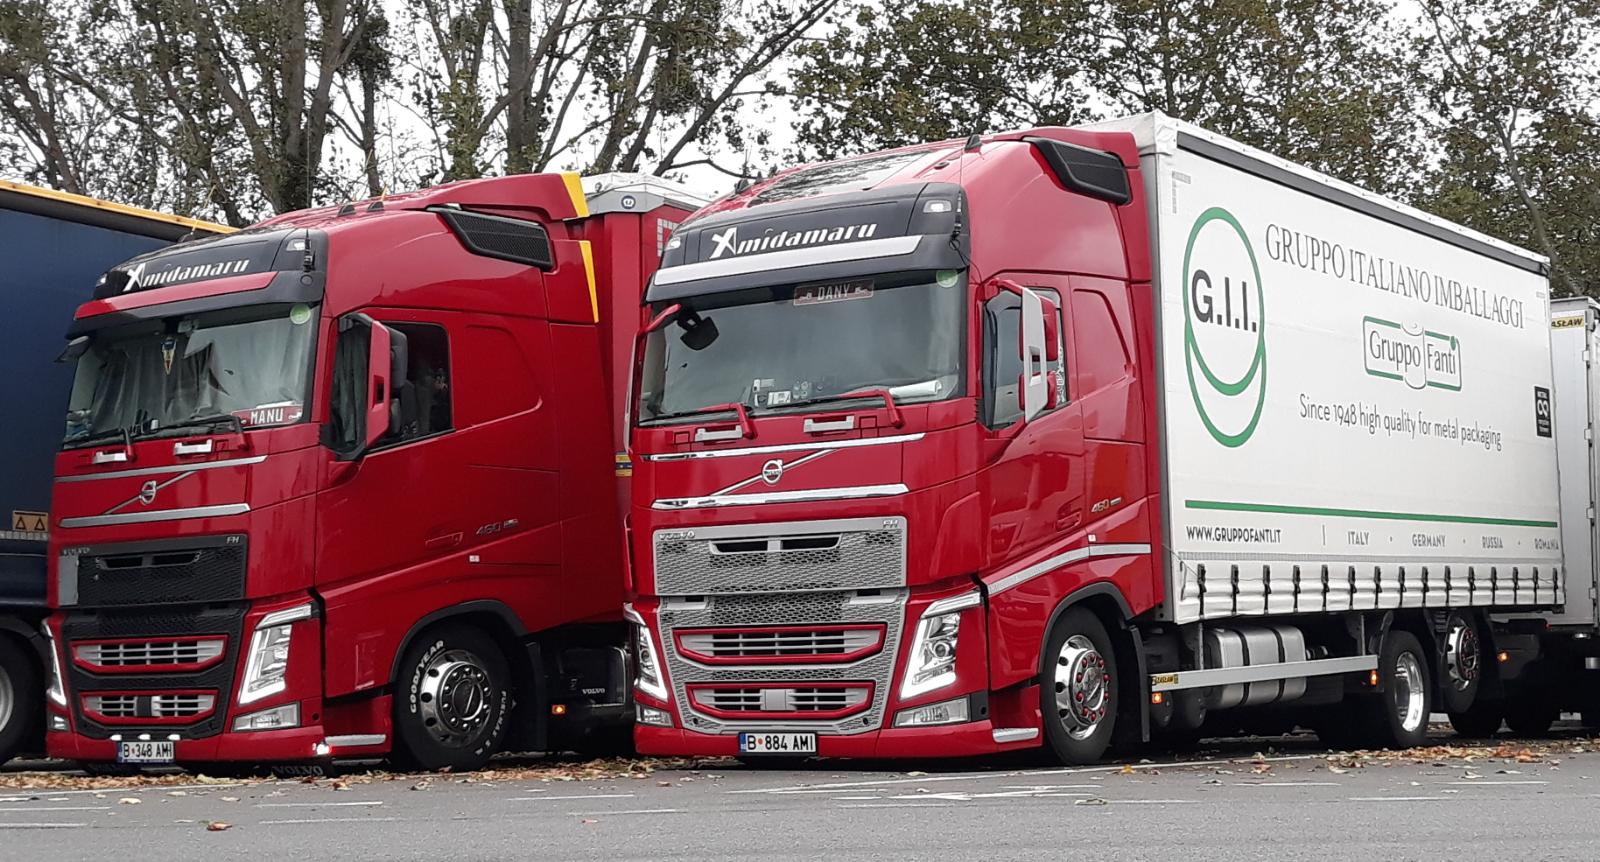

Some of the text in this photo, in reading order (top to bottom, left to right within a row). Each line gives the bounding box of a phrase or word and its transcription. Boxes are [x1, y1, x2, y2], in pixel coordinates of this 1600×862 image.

[1266, 224, 1524, 328] GRUPPO ITALIANO IMBALLAGGI
[817, 283, 850, 300] DANY
[1192, 269, 1257, 332] G.I.I.
[1551, 318, 1583, 327] ASŁAW
[1370, 330, 1456, 374] Gruppo Fanti
[250, 408, 284, 424] MANU
[1300, 393, 1502, 451] Since 1948 high quality for metal packaging
[1186, 526, 1281, 543] WWW.GRUPPOFANTI.IT
[1348, 531, 1370, 545] ITALY
[1411, 534, 1446, 547] GERMANY
[1482, 536, 1504, 548] RUSSIA
[410, 640, 444, 714] GOODYEAR
[123, 743, 173, 758] B 348 AMI
[748, 735, 814, 750] B 884 AMI
